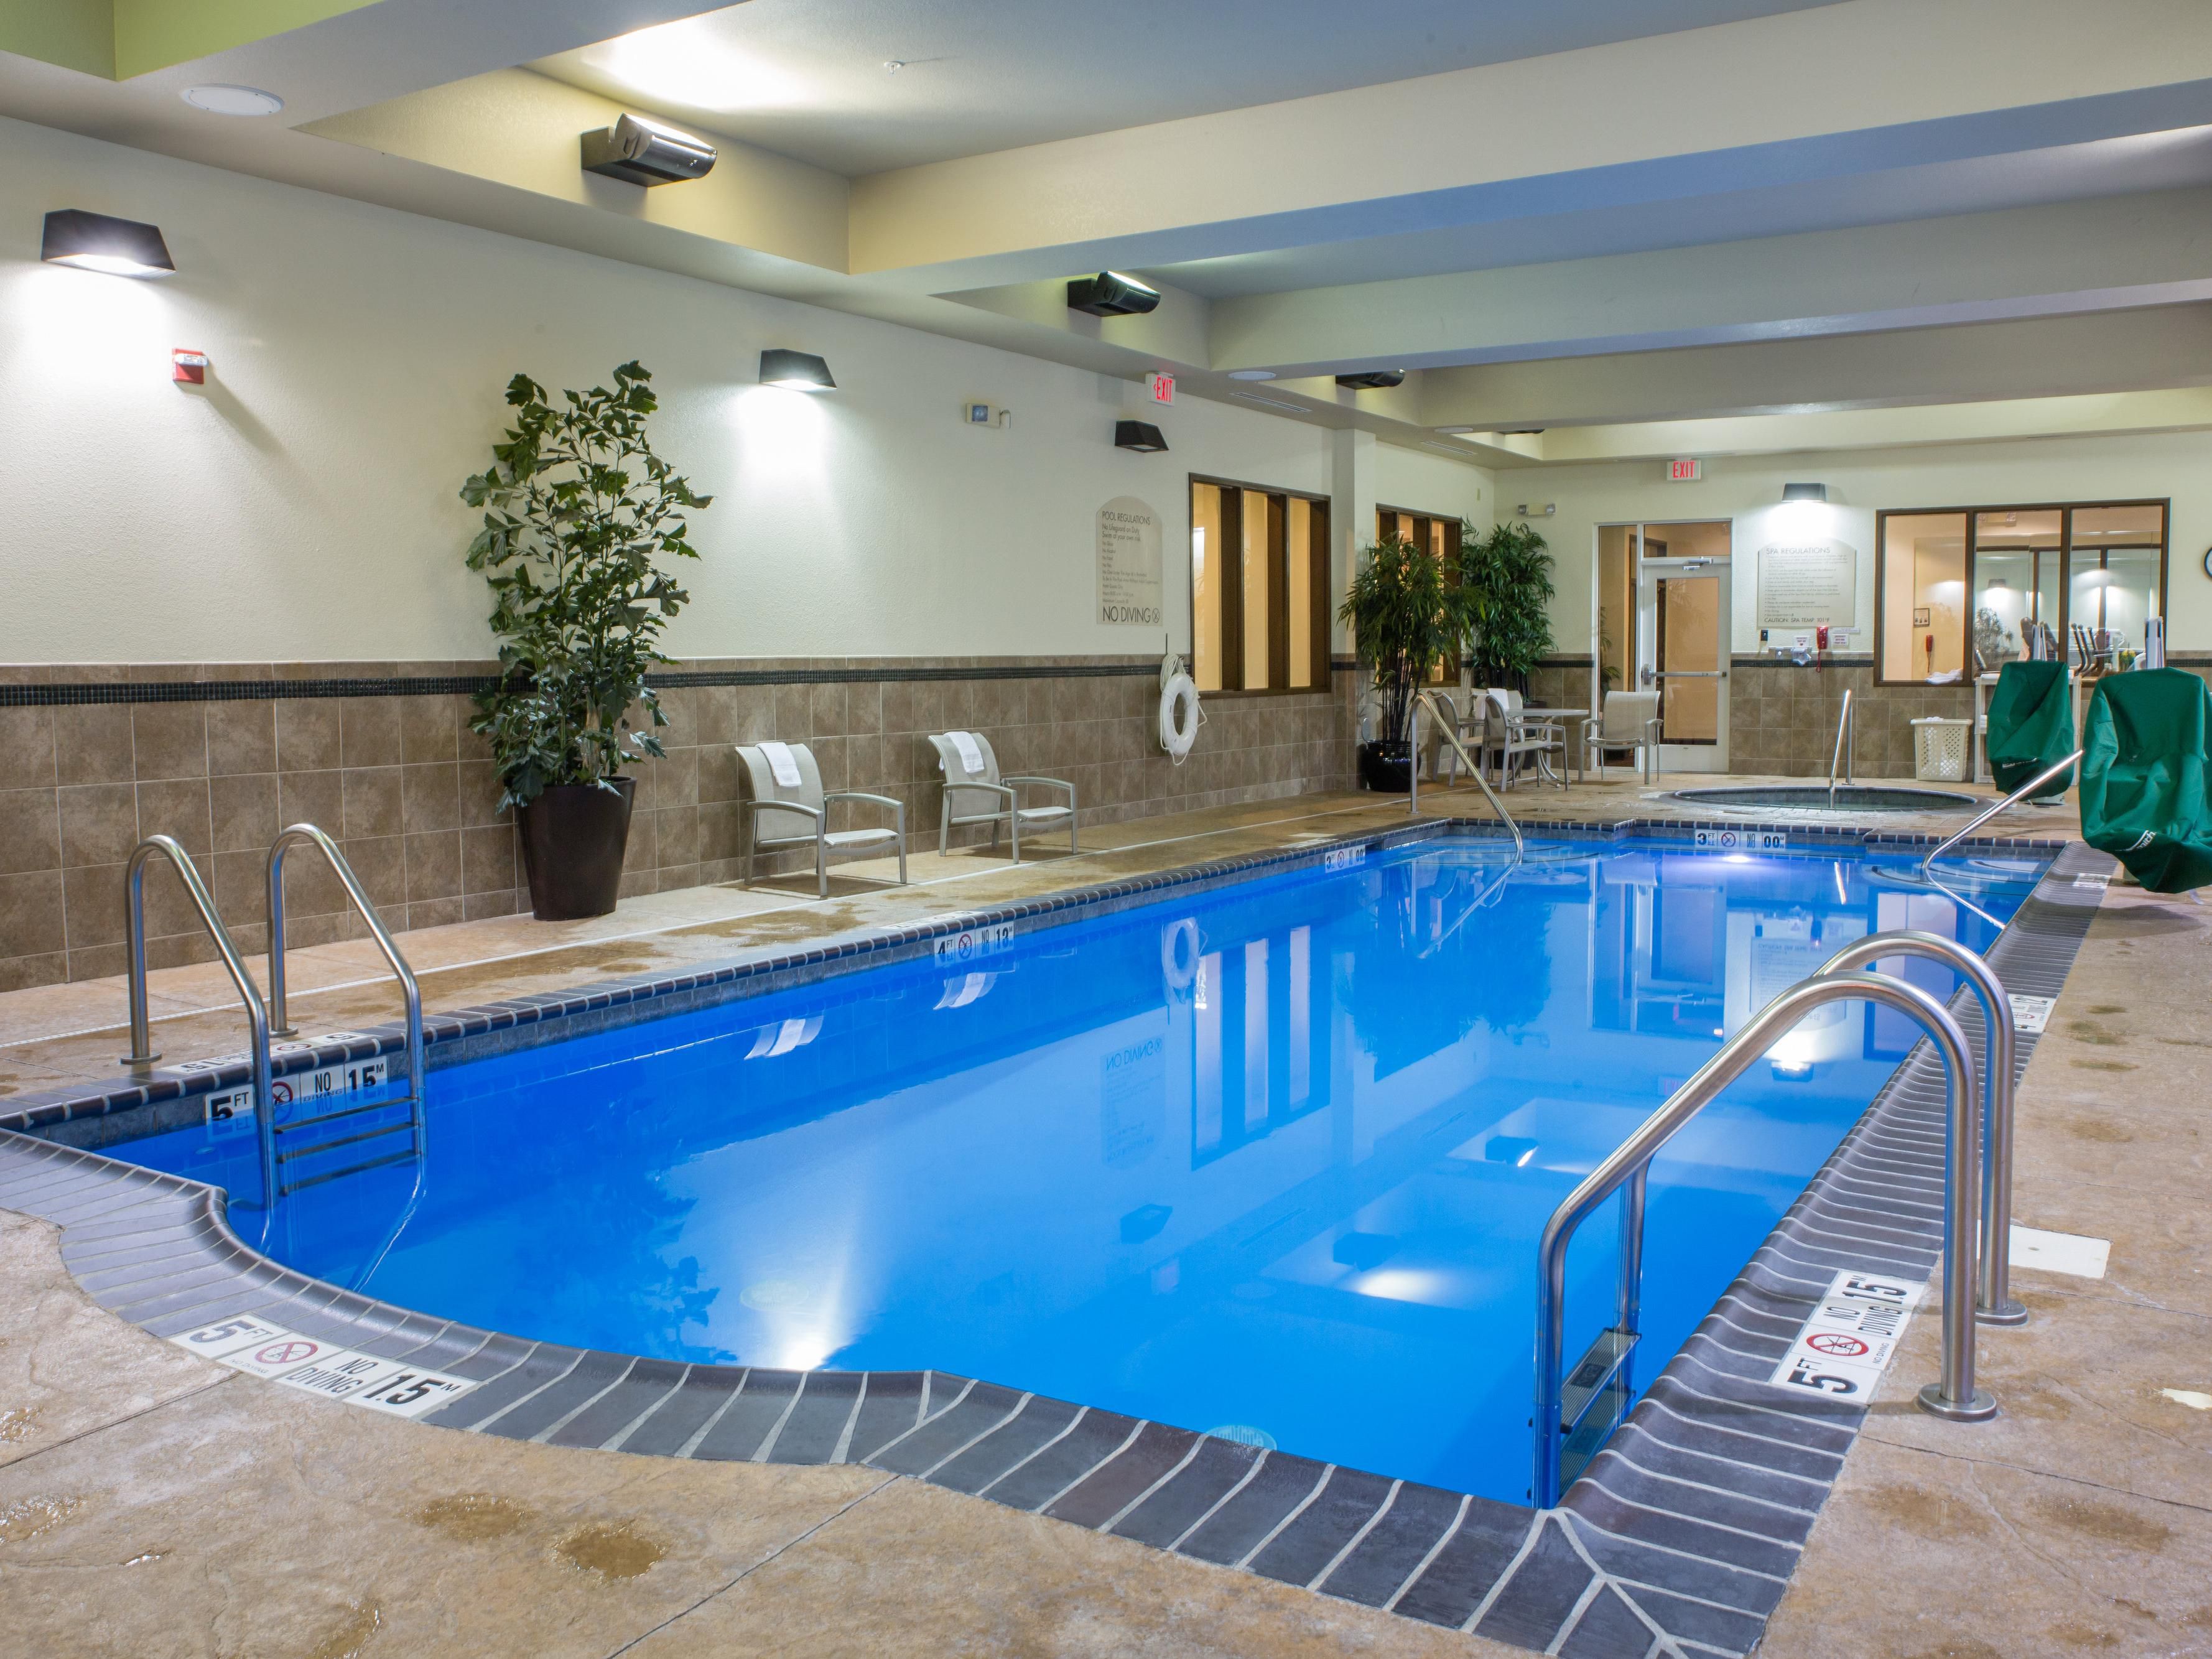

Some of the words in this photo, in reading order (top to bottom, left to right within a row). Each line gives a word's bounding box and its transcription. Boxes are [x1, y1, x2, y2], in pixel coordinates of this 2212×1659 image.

[1156, 375, 1173, 403] EXIT
[1673, 460, 1695, 478] EXIT
[1102, 511, 1117, 521] POOL
[1117, 513, 1151, 526] REGULATIONS
[1781, 547, 1830, 555] REGULATIONS
[1103, 605, 1118, 622] NO
[1121, 606, 1151, 623] DIVING
[982, 929, 990, 944] NO
[211, 1095, 233, 1121] 5
[235, 1091, 249, 1107] FT
[315, 1071, 331, 1093] NO
[1823, 1306, 1861, 1321] NO
[1857, 1306, 1903, 1336] DIVING
[190, 1319, 256, 1343] 5
[243, 1328, 274, 1339] FT
[1875, 1342, 1890, 1357] DIVING
[335, 1358, 378, 1375] NO
[1796, 1357, 1822, 1371] FT
[286, 1367, 364, 1393] DIVING
[1787, 1369, 1858, 1394] 5
